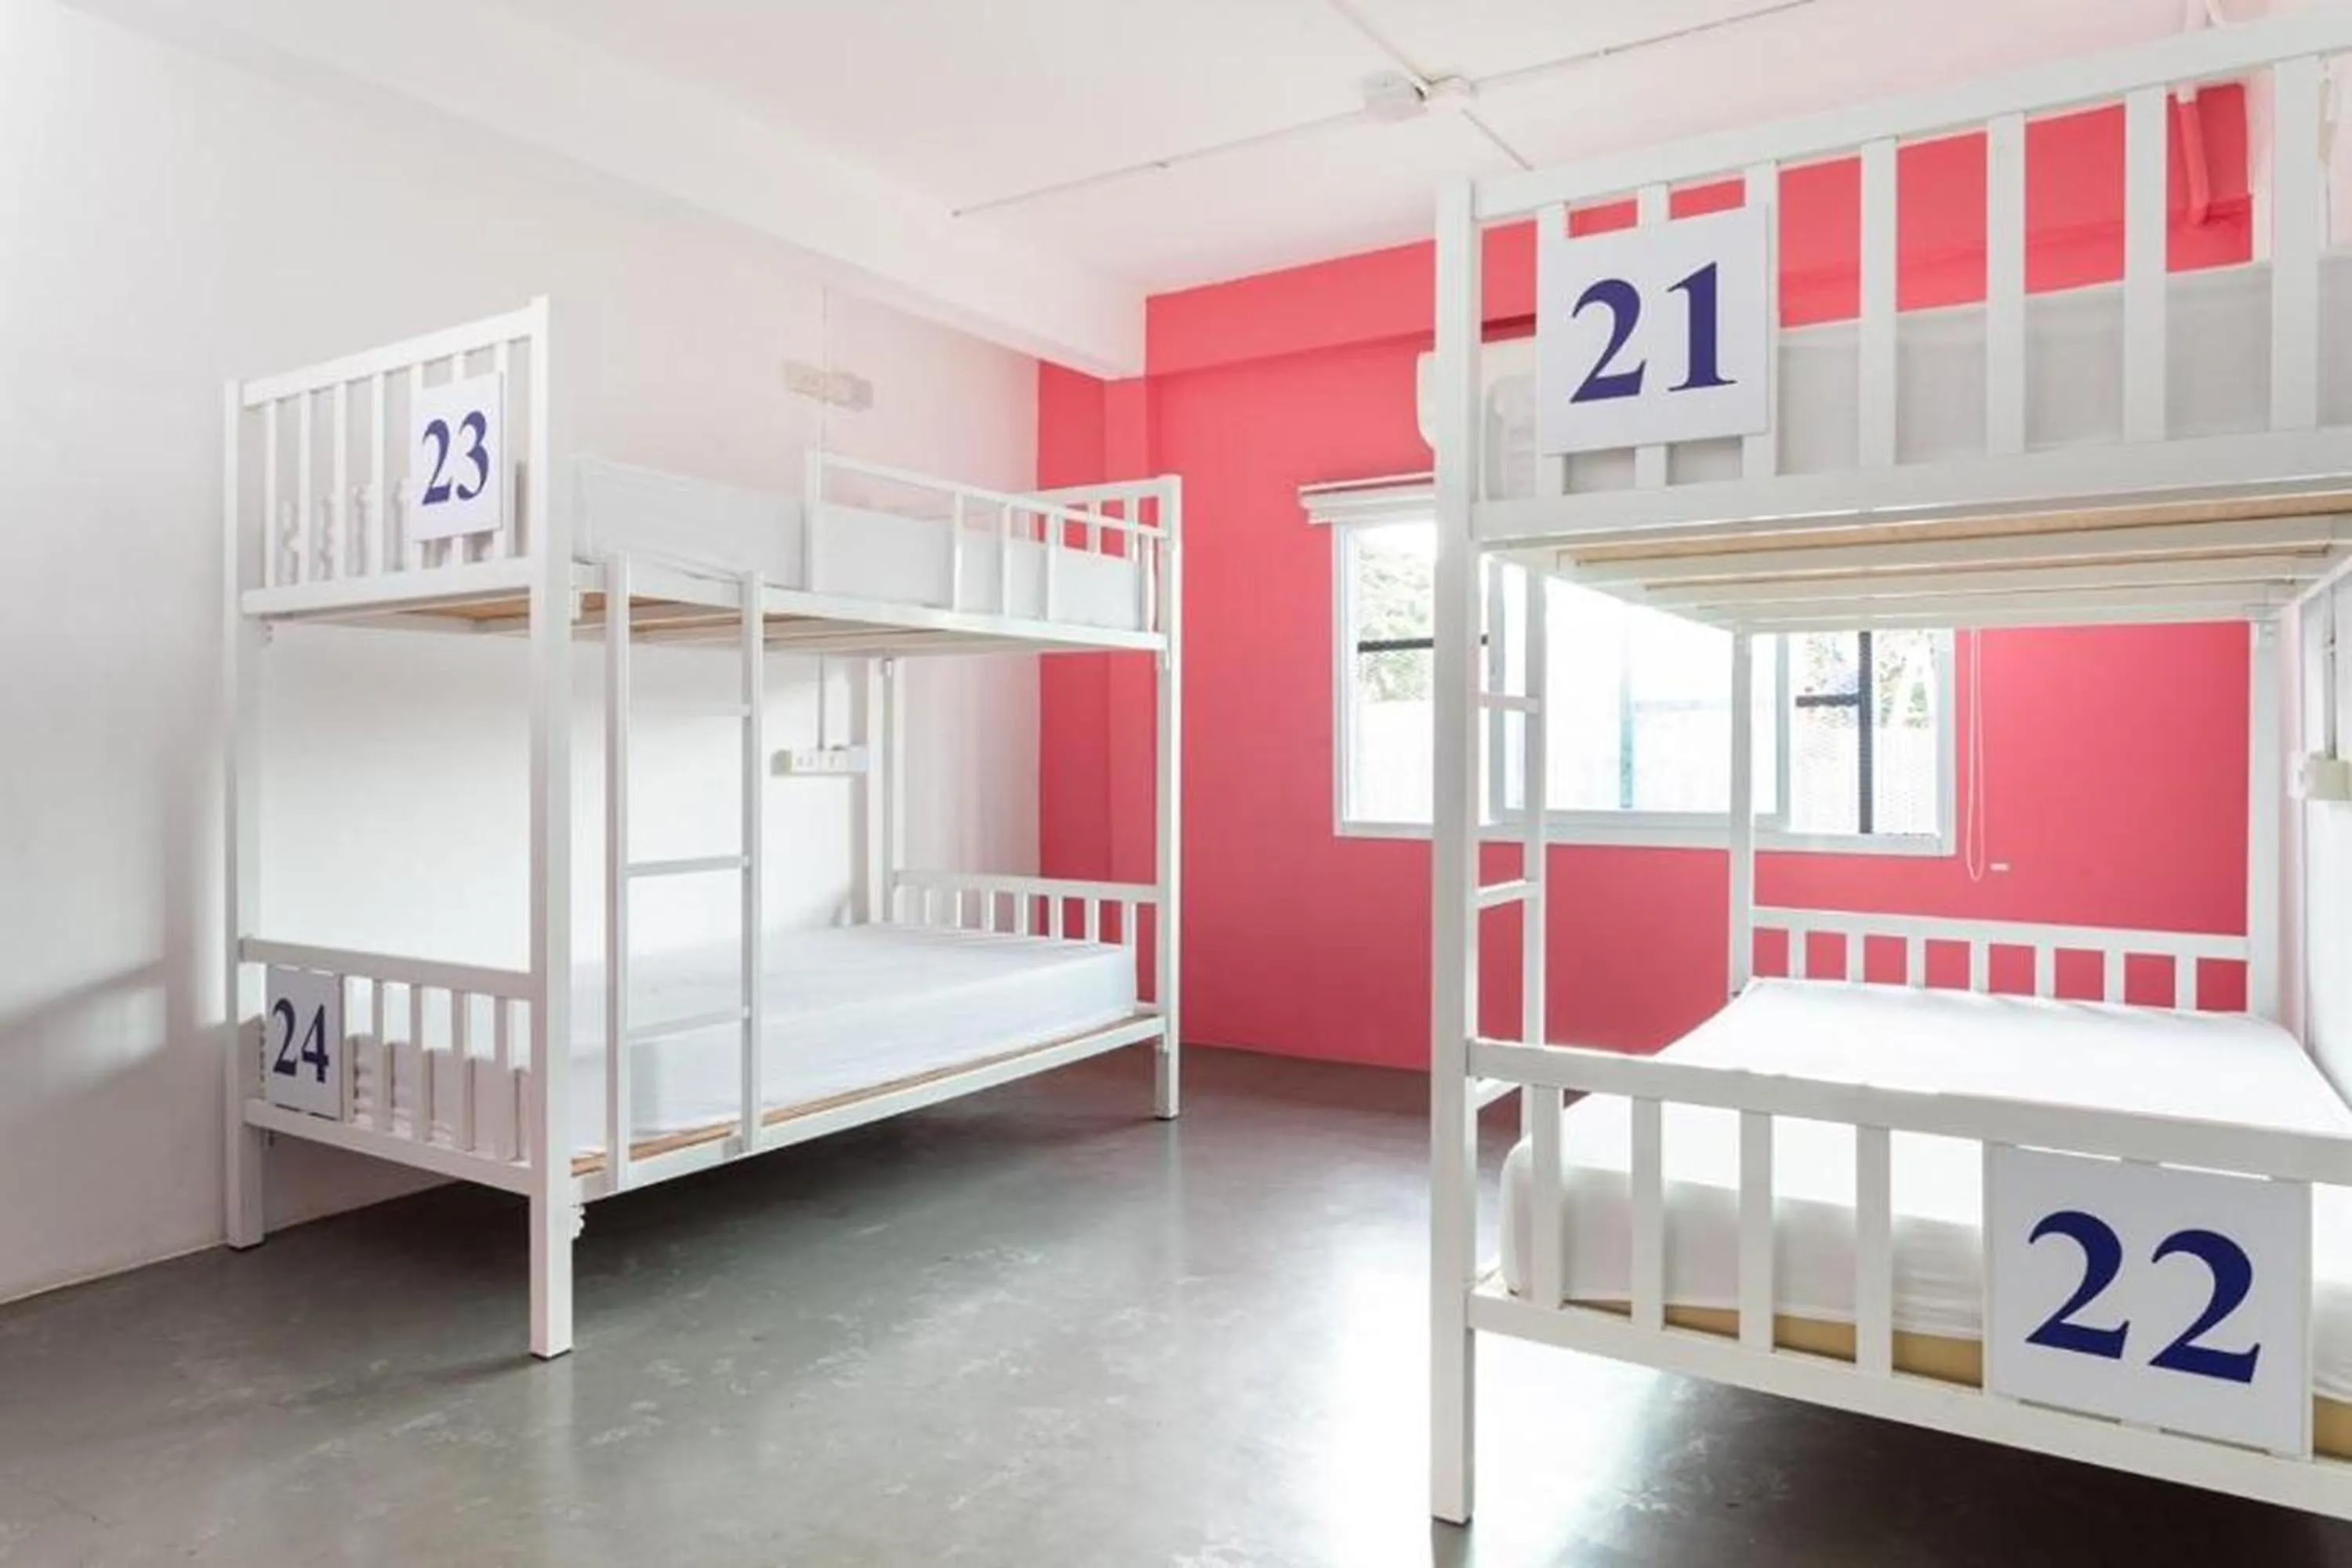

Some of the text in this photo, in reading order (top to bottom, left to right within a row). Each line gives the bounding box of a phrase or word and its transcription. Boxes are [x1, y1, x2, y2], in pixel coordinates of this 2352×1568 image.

[1570, 262, 1737, 404] 21
[421, 409, 490, 506] 23
[271, 997, 330, 1083] 24
[2025, 1210, 2261, 1384] 22
